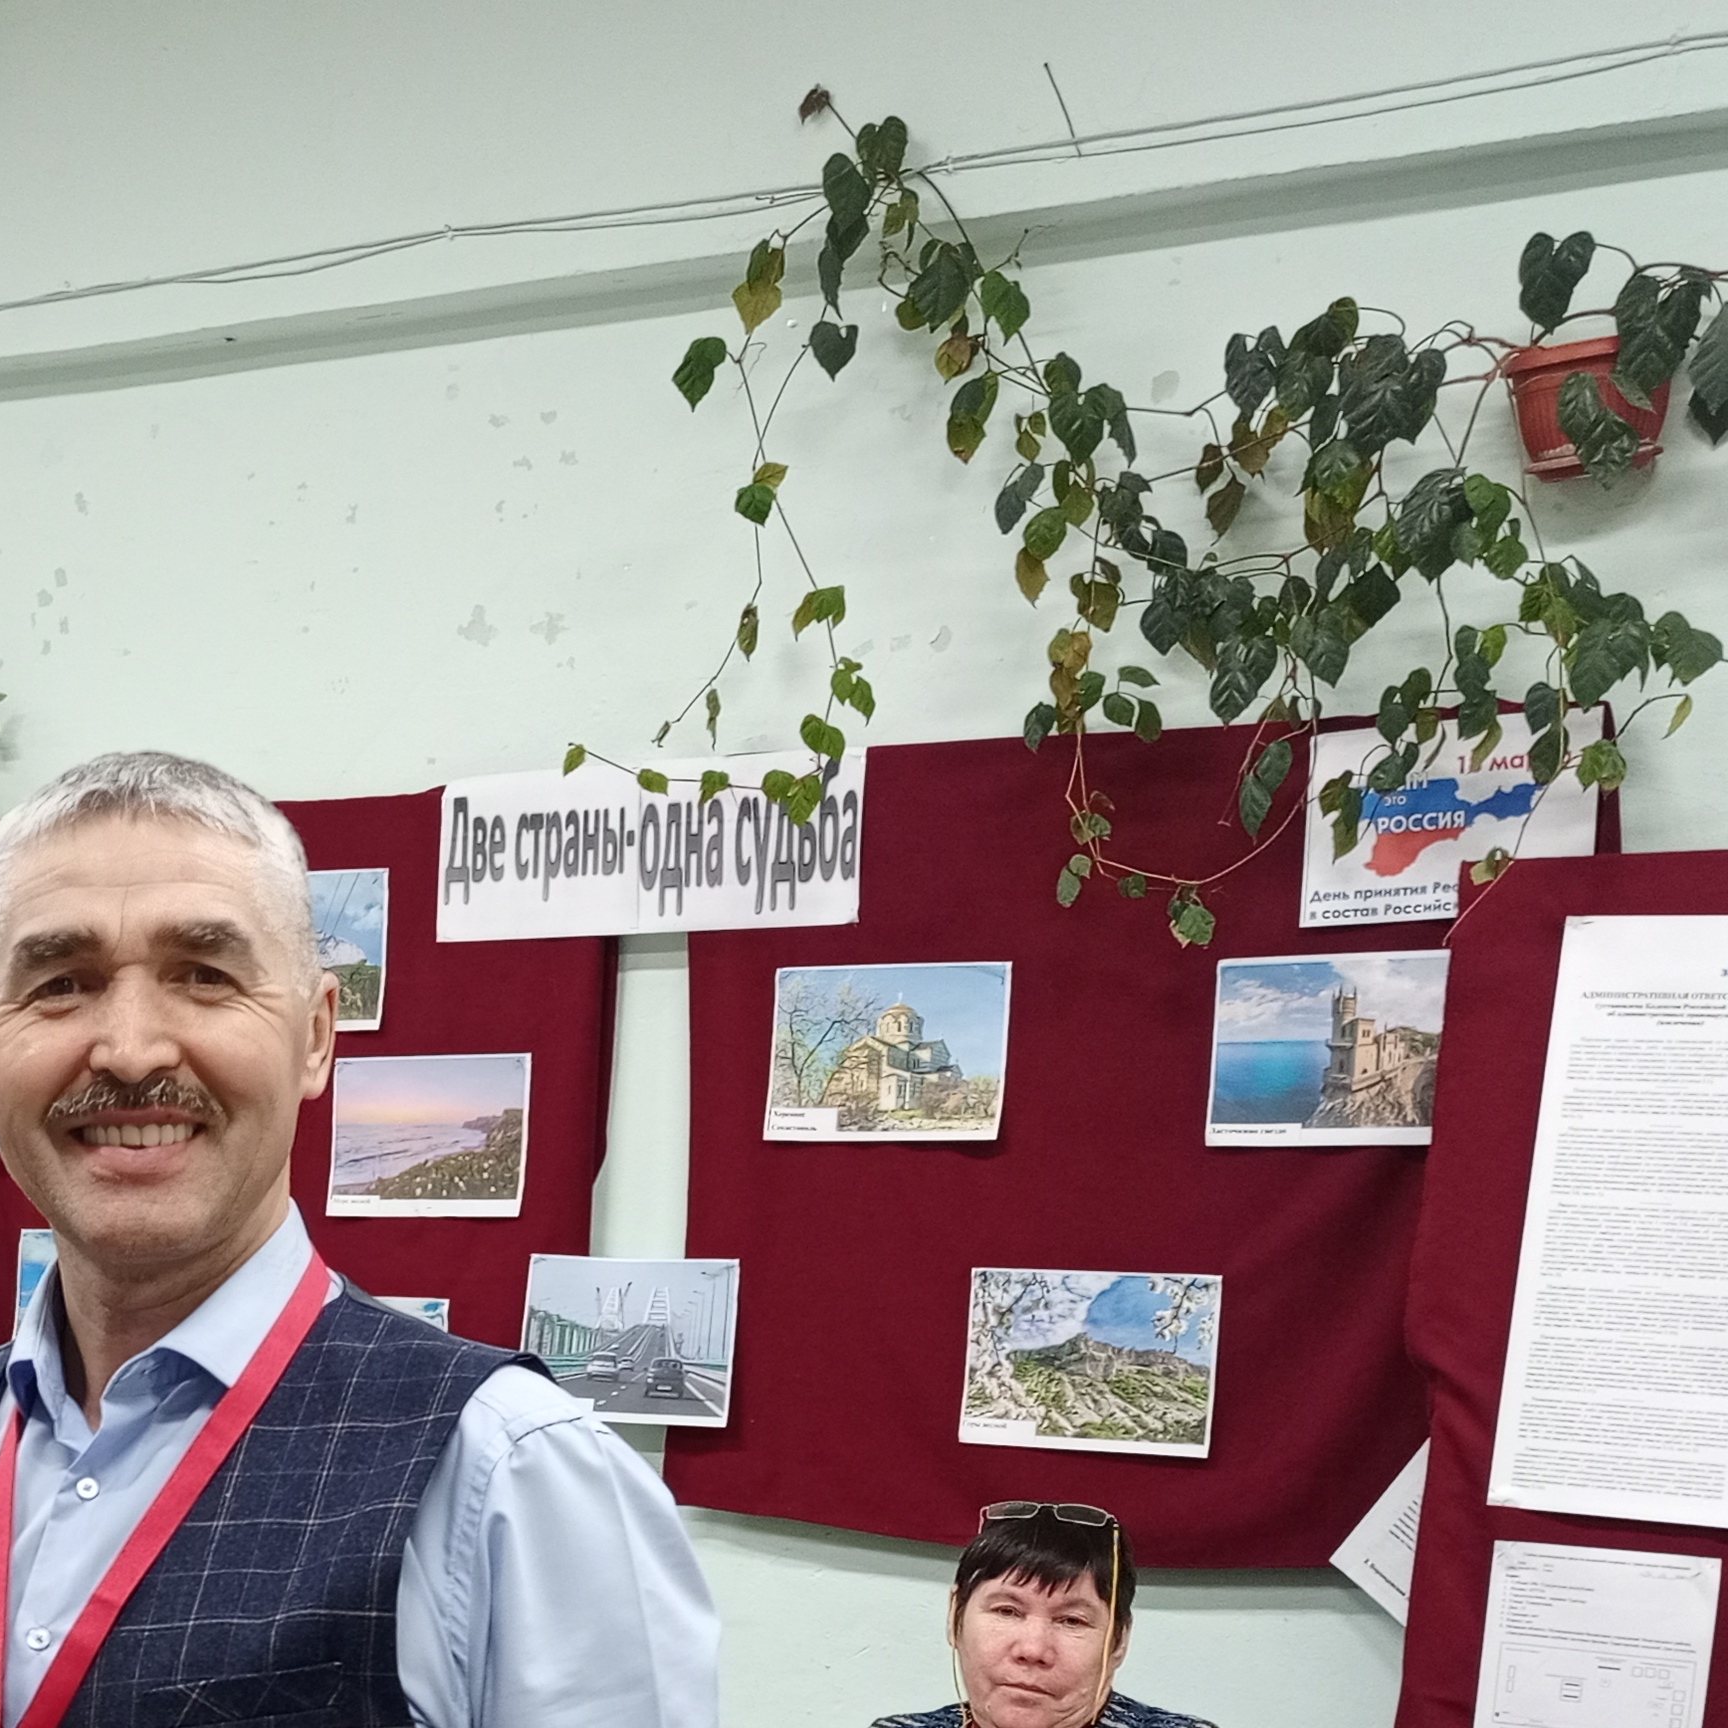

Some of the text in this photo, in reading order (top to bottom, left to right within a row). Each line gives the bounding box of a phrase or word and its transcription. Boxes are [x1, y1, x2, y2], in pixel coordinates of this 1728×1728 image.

[1384, 796, 1406, 807] это
[1377, 810, 1466, 835] РОССИЯ
[444, 796, 506, 905] Две
[734, 757, 858, 915] судьба
[1310, 890, 1349, 903] День
[1354, 885, 1427, 902] принятия
[1322, 907, 1378, 919] состав
